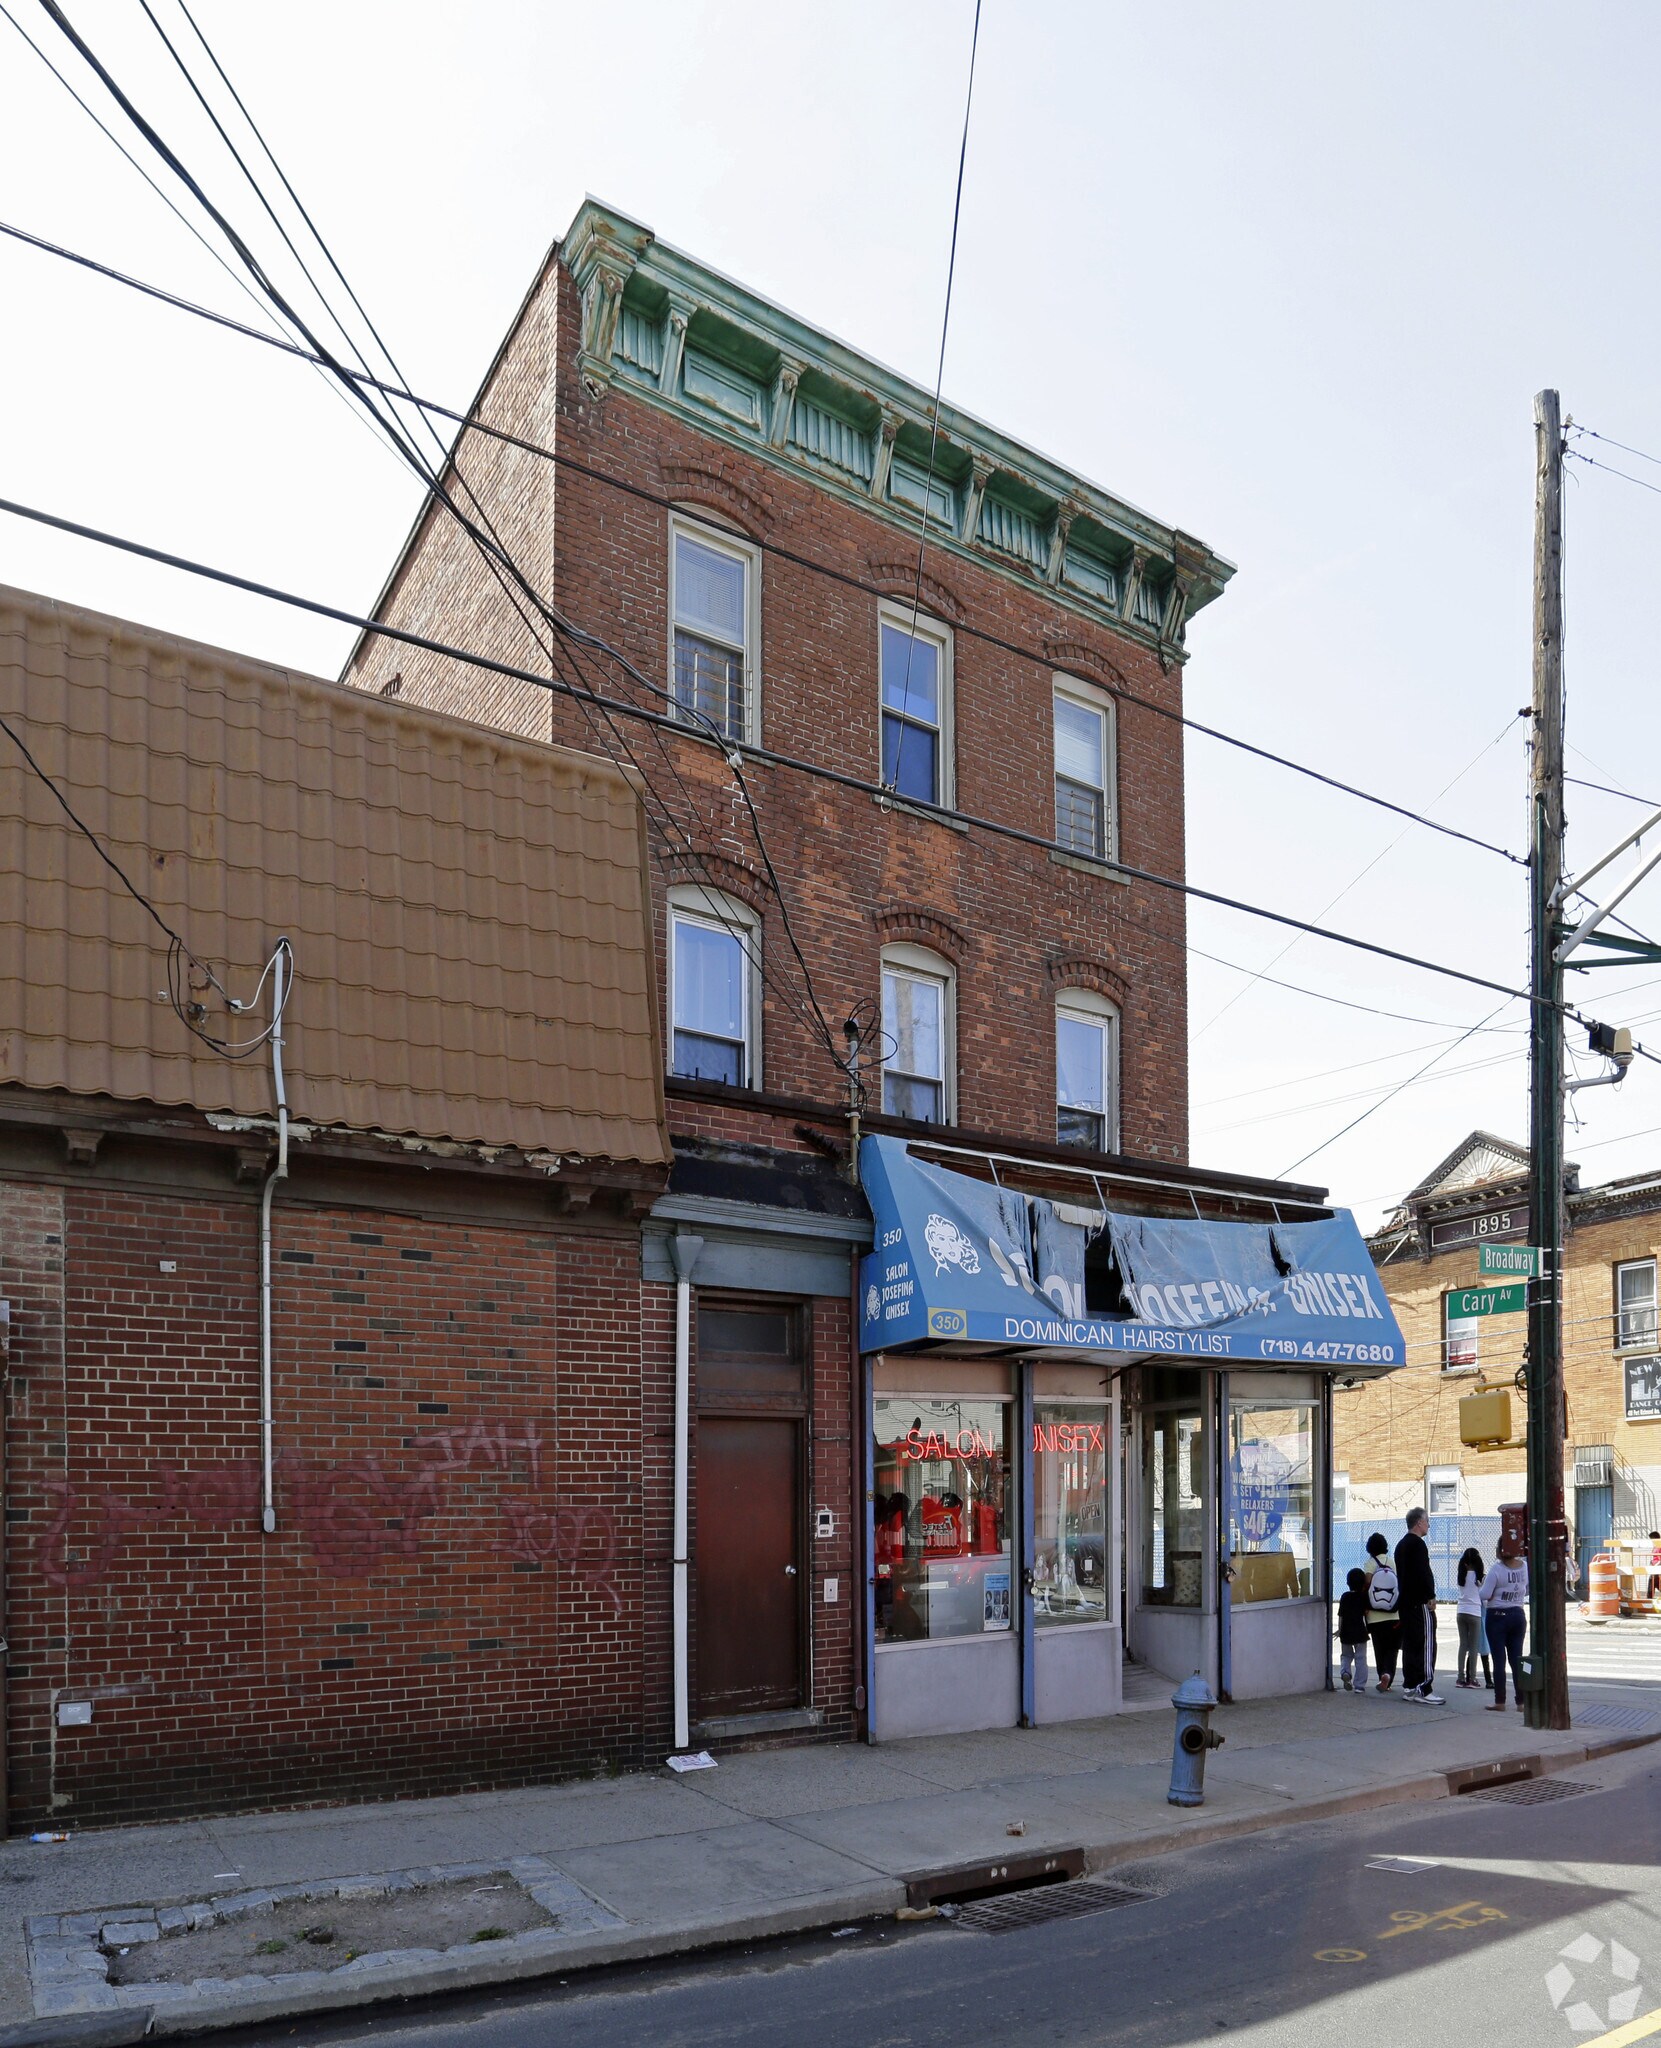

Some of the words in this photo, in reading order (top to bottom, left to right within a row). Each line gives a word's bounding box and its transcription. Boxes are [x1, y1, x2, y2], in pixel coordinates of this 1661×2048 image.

[1472, 1213, 1512, 1236] 1895
[882, 1228, 902, 1248] 350
[1485, 1248, 1534, 1275] Broadway
[885, 1262, 909, 1282] SALON
[882, 1280, 914, 1305] JOSEFINA
[1283, 1272, 1384, 1319] UNISEX
[1462, 1293, 1496, 1315] Cary
[1500, 1288, 1512, 1300] Av
[885, 1300, 910, 1320] UNISEX
[935, 1315, 960, 1331] 350
[1005, 1318, 1114, 1345] DOMINICAN
[1123, 1327, 1232, 1354] HAIRSTYLIST
[1260, 1338, 1298, 1358] (718)
[1301, 1341, 1394, 1362] 447-7680
[1629, 1363, 1654, 1378] NEW
[906, 1428, 994, 1460] SALON
[1232, 1471, 1253, 1484] WASH
[1232, 1485, 1238, 1497] &
[1240, 1485, 1253, 1497] SET
[1081, 1503, 1101, 1520] OPEN
[1240, 1499, 1275, 1511] RELAXERS
